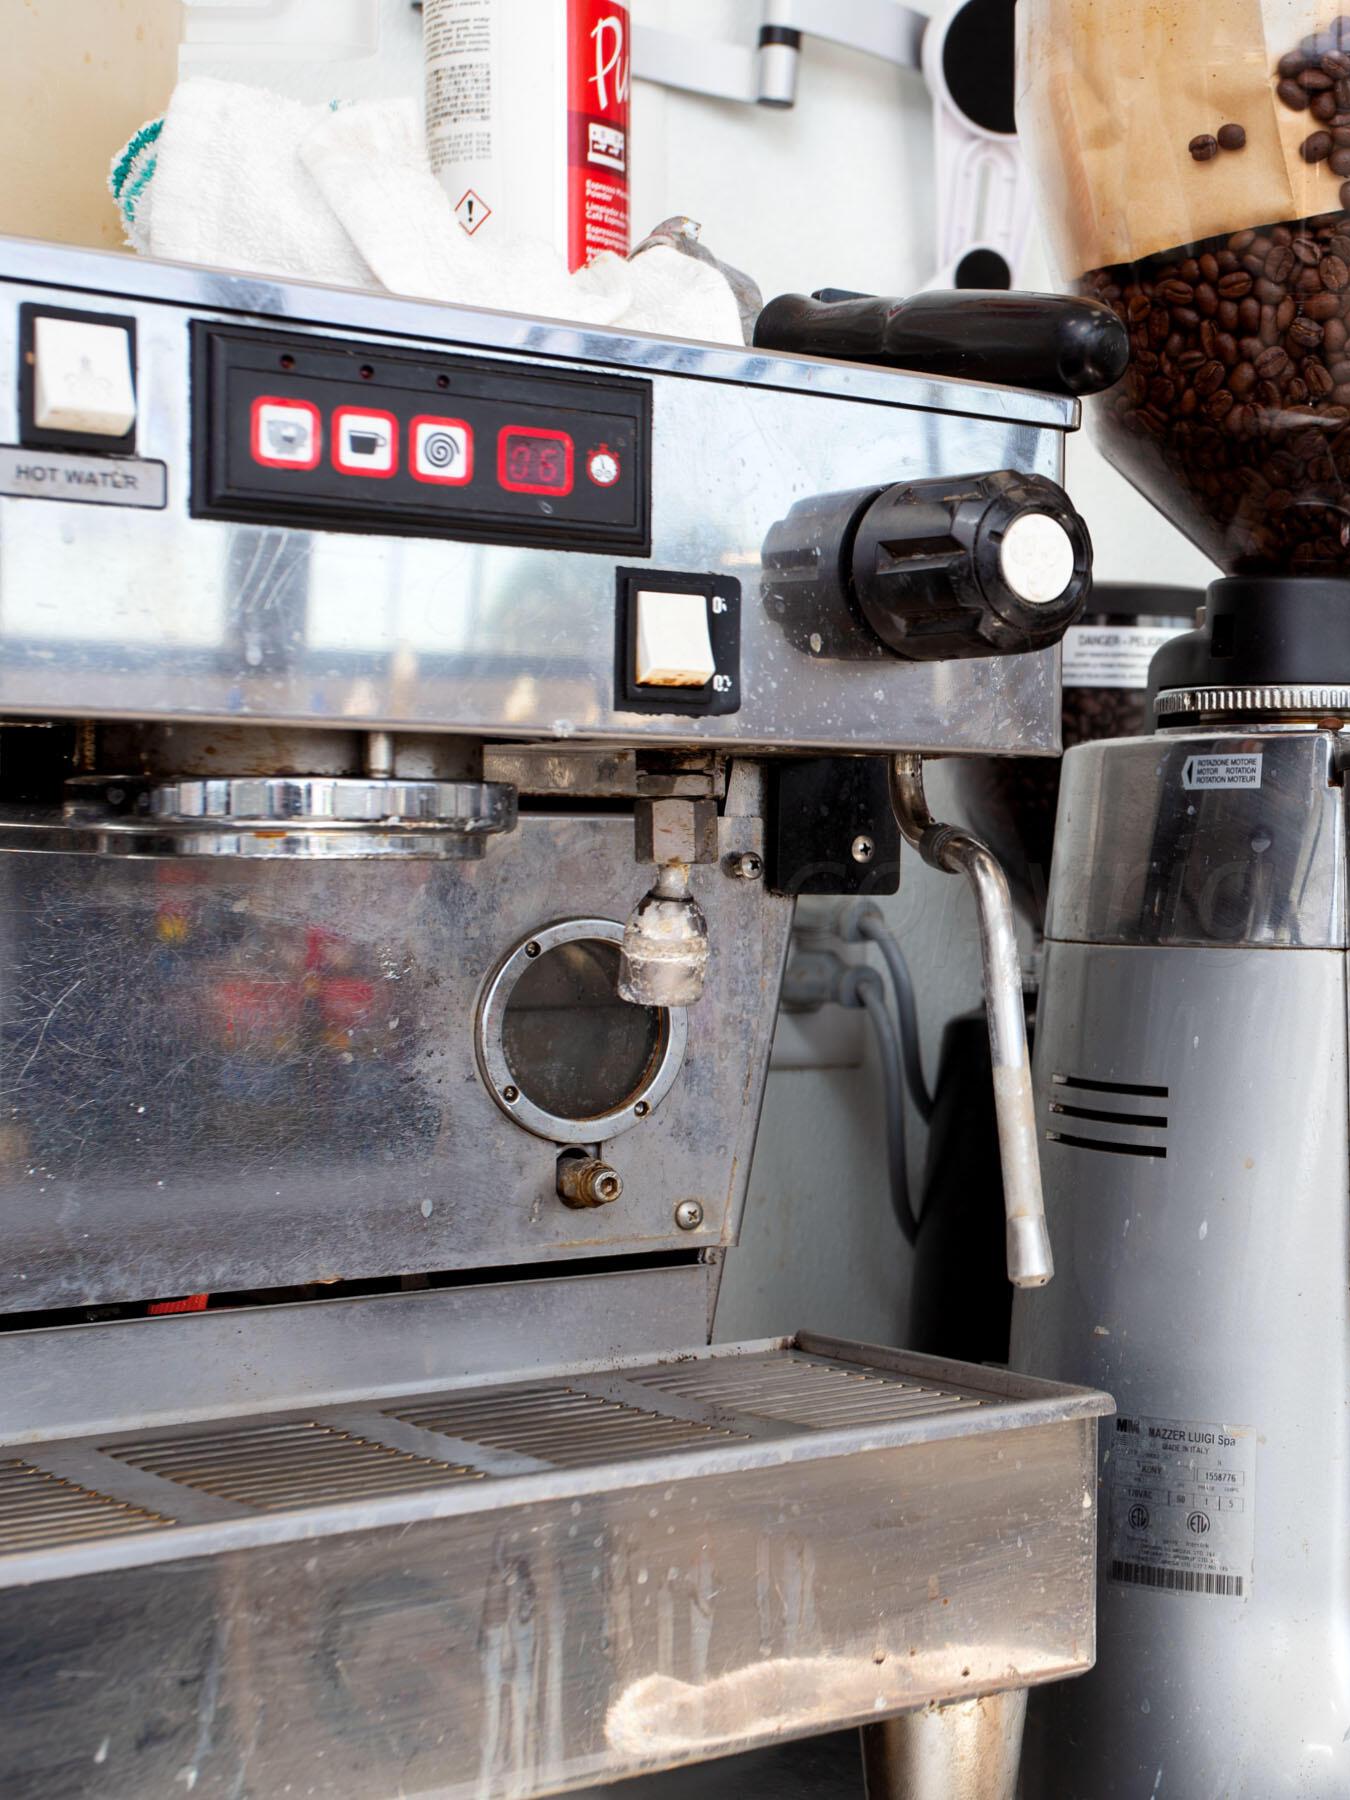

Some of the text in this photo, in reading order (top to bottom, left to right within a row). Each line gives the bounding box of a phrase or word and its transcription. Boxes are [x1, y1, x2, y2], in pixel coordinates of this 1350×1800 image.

[15, 464, 139, 489] HOT WATER
[1230, 757, 1257, 766] MOTORE
[1197, 766, 1257, 775] MOTOR ROTATION
[1196, 775, 1256, 784] ROTATION MOTEUR
[1148, 1427, 1186, 1442] MAZZER
[1188, 1431, 1215, 1445] LUIGI
[1217, 1434, 1237, 1448] Spa
[1162, 1443, 1181, 1453] MADE
[1190, 1446, 1210, 1455] ITALY
